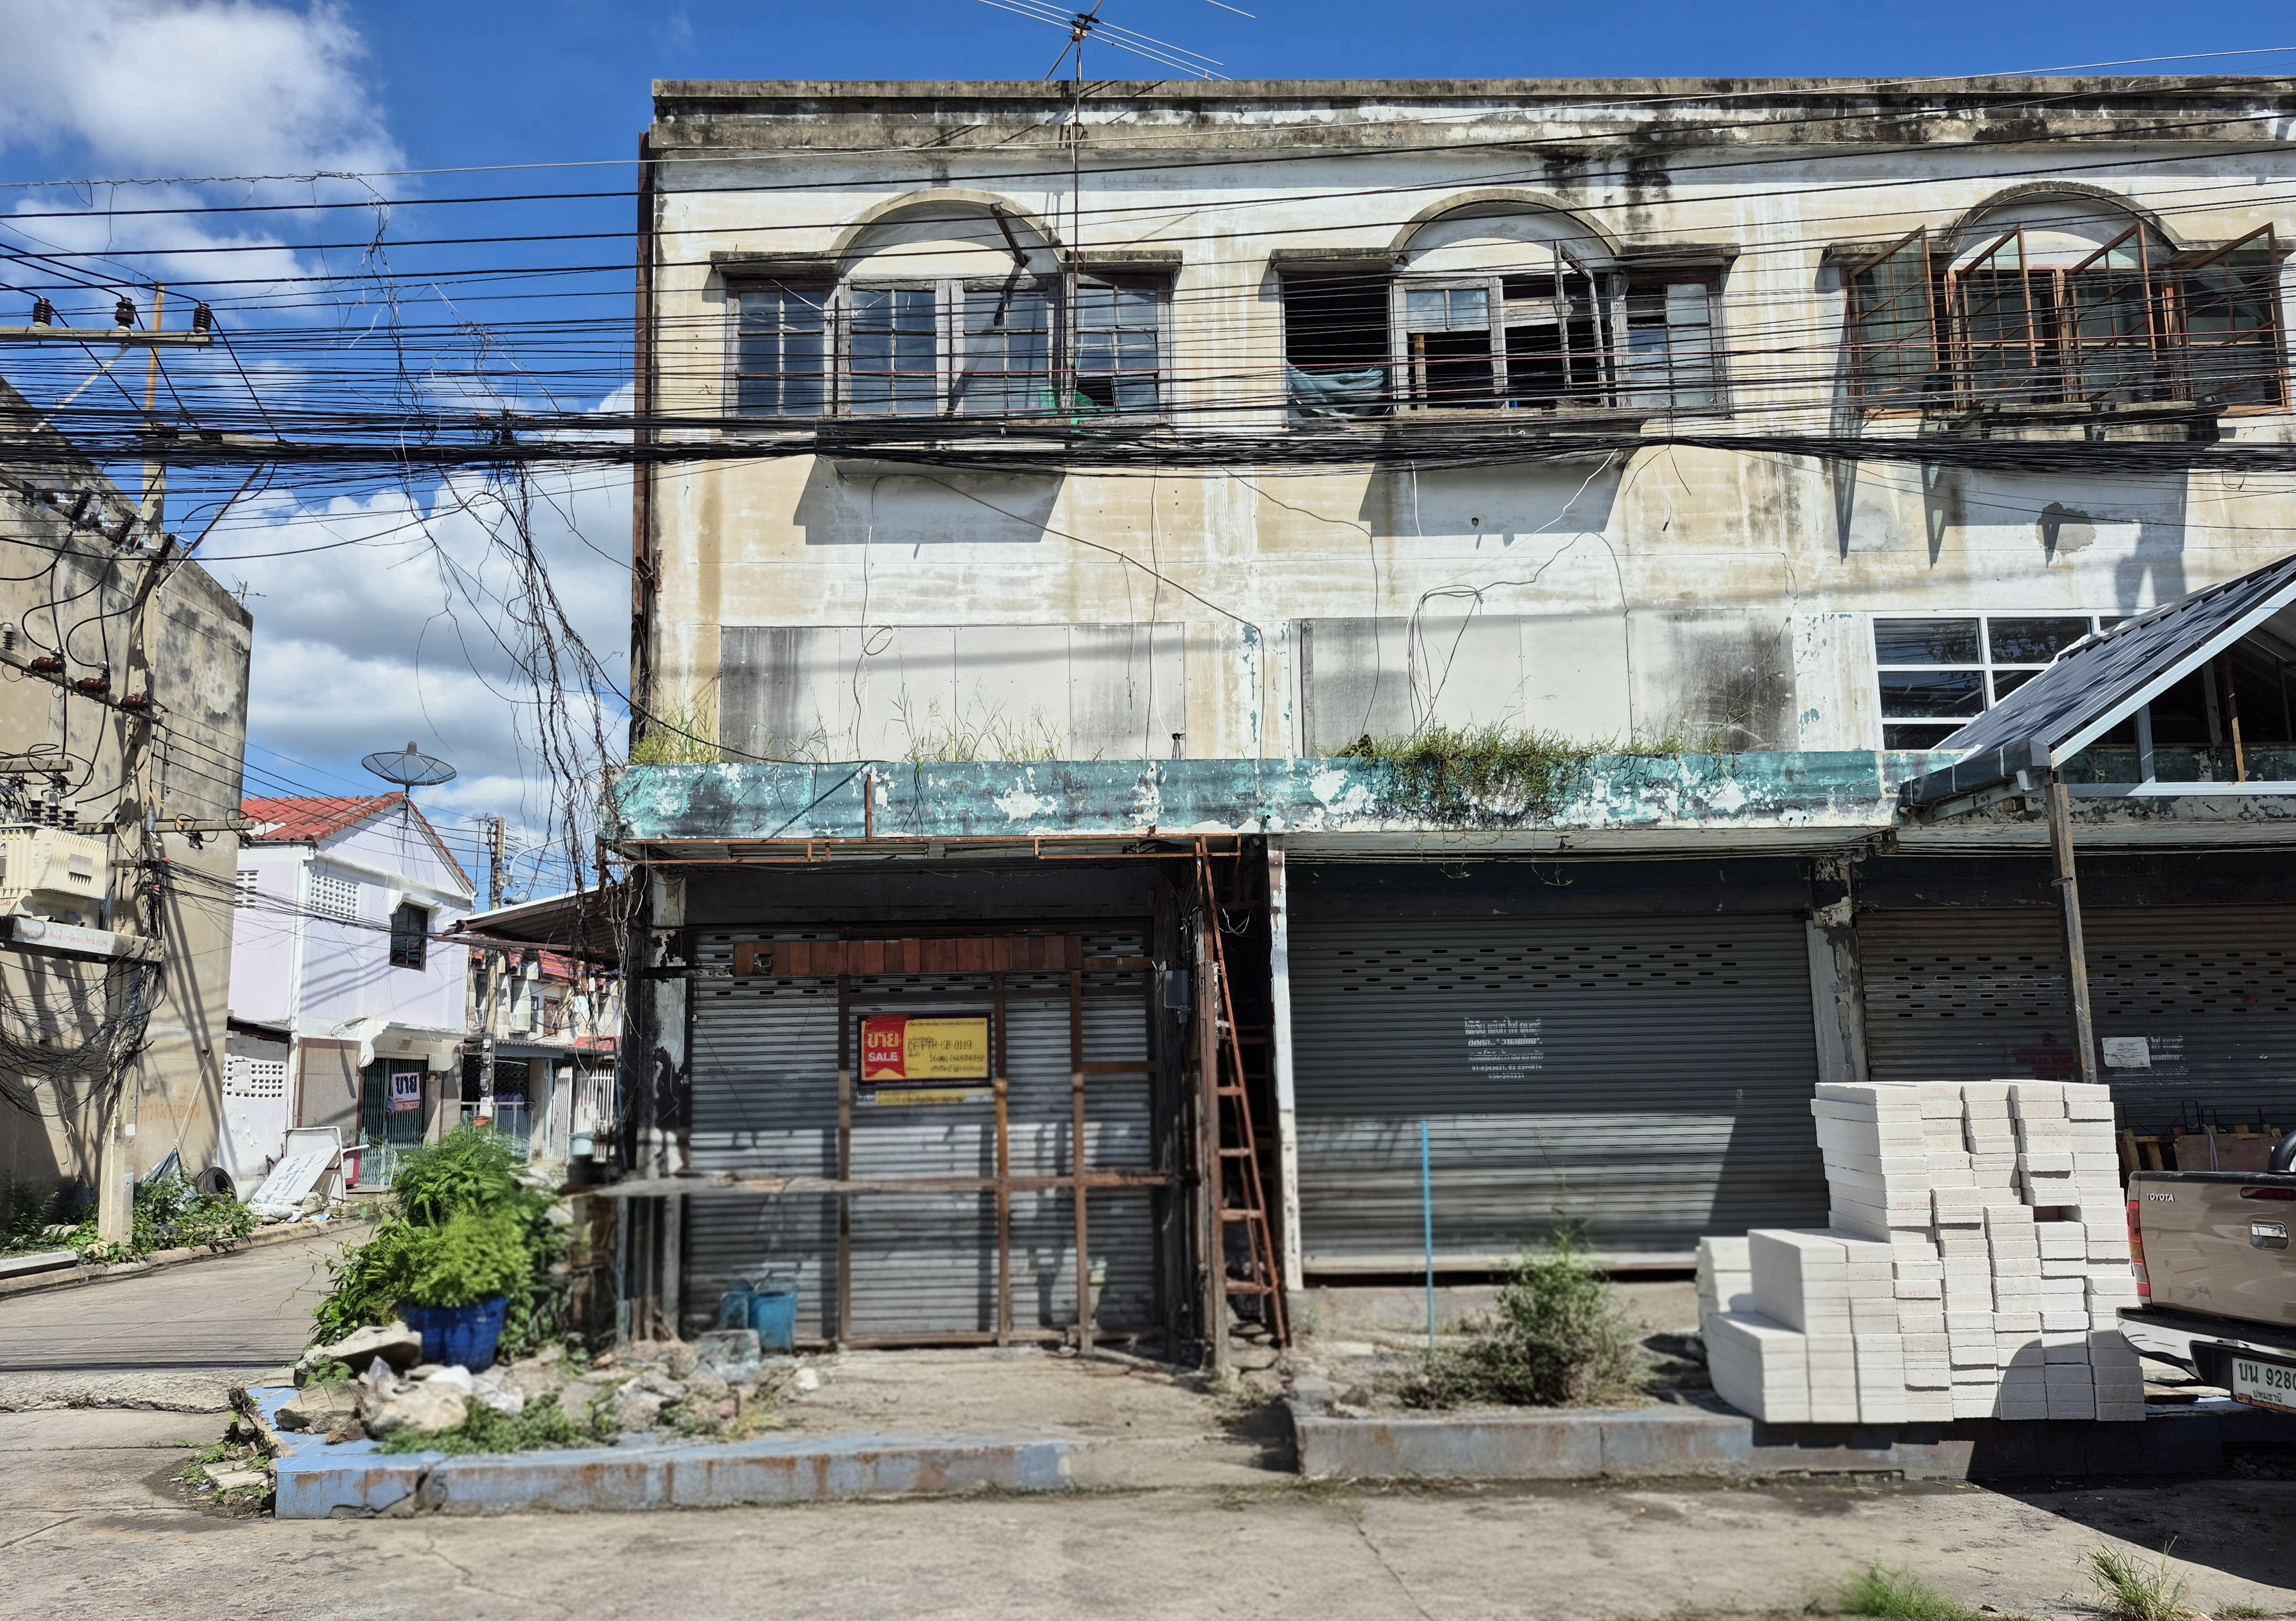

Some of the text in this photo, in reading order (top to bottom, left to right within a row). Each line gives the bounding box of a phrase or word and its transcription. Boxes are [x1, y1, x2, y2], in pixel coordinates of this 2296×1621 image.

[867, 1033, 899, 1048] ขาย
[868, 1052, 898, 1061] SALE
[395, 1075, 417, 1095] ขาย
[2146, 1192, 2174, 1202] TOYOTA
[2239, 1362, 2259, 1384] บน
[2253, 1389, 2282, 1402] ปทุมธานี
